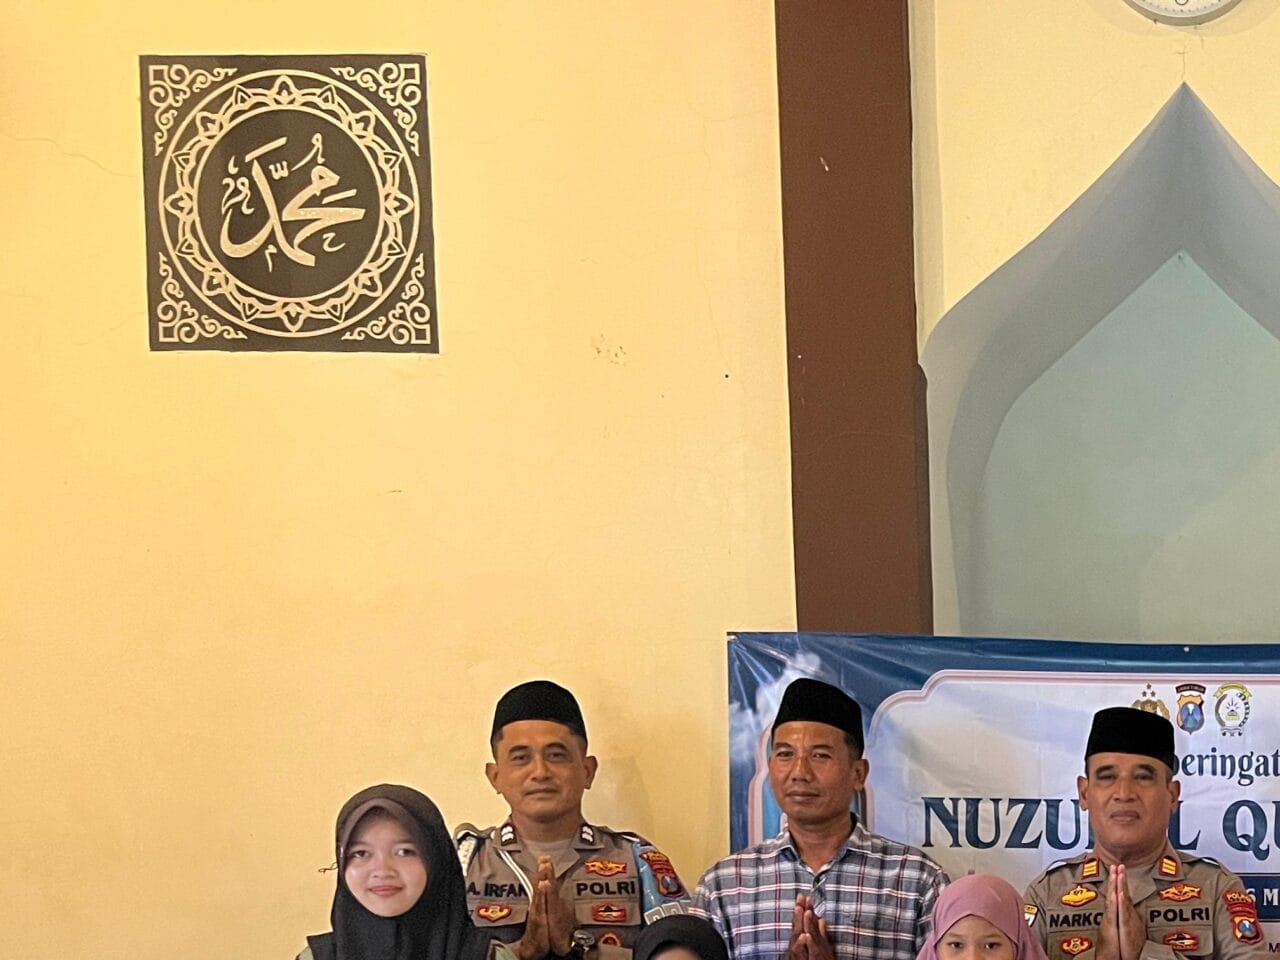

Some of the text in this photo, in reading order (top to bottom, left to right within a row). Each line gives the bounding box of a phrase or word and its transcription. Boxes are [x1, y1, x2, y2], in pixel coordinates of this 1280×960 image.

[921, 797, 1201, 851] NUZUL
[576, 881, 636, 896] POLRI
[1150, 907, 1210, 923] POLRI
